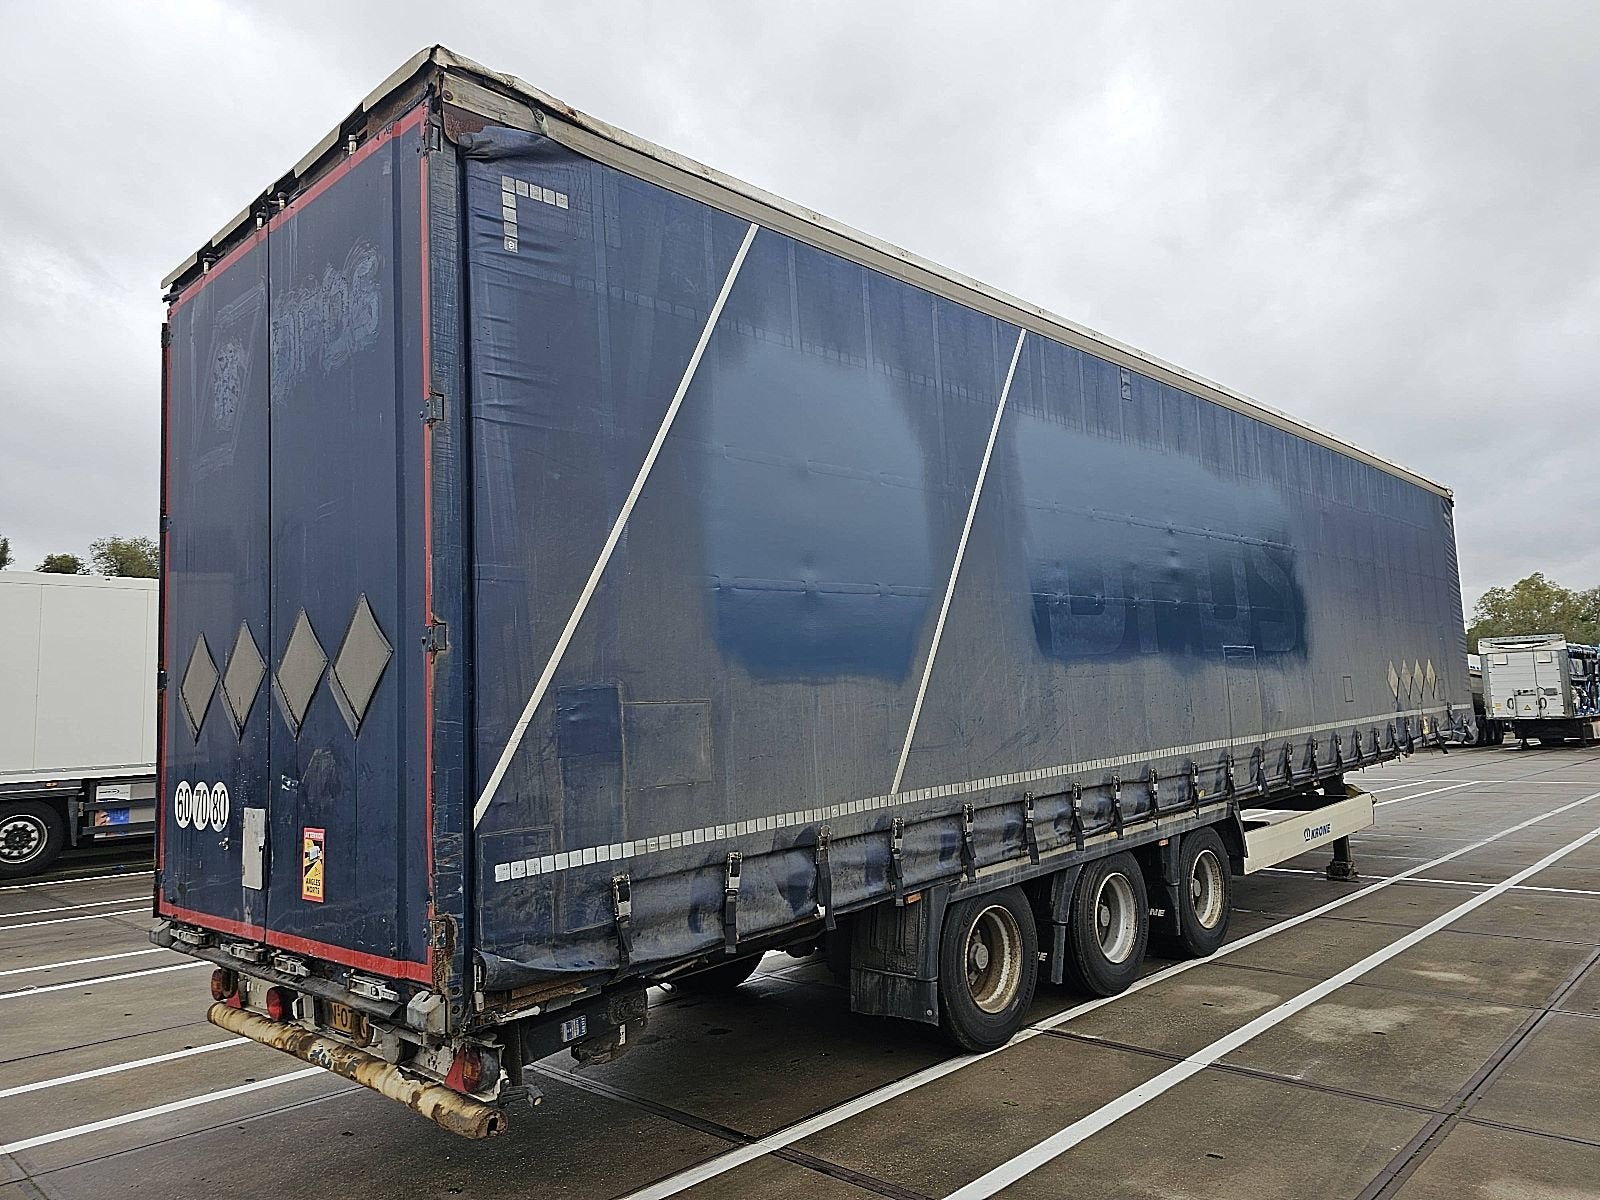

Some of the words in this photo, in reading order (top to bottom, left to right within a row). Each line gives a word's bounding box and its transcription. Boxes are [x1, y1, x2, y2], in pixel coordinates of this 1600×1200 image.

[177, 788, 190, 822] 60
[195, 789, 208, 824] 70
[212, 789, 226, 826] 80
[1310, 823, 1331, 840] KRONE
[305, 877, 321, 887] ANGLES
